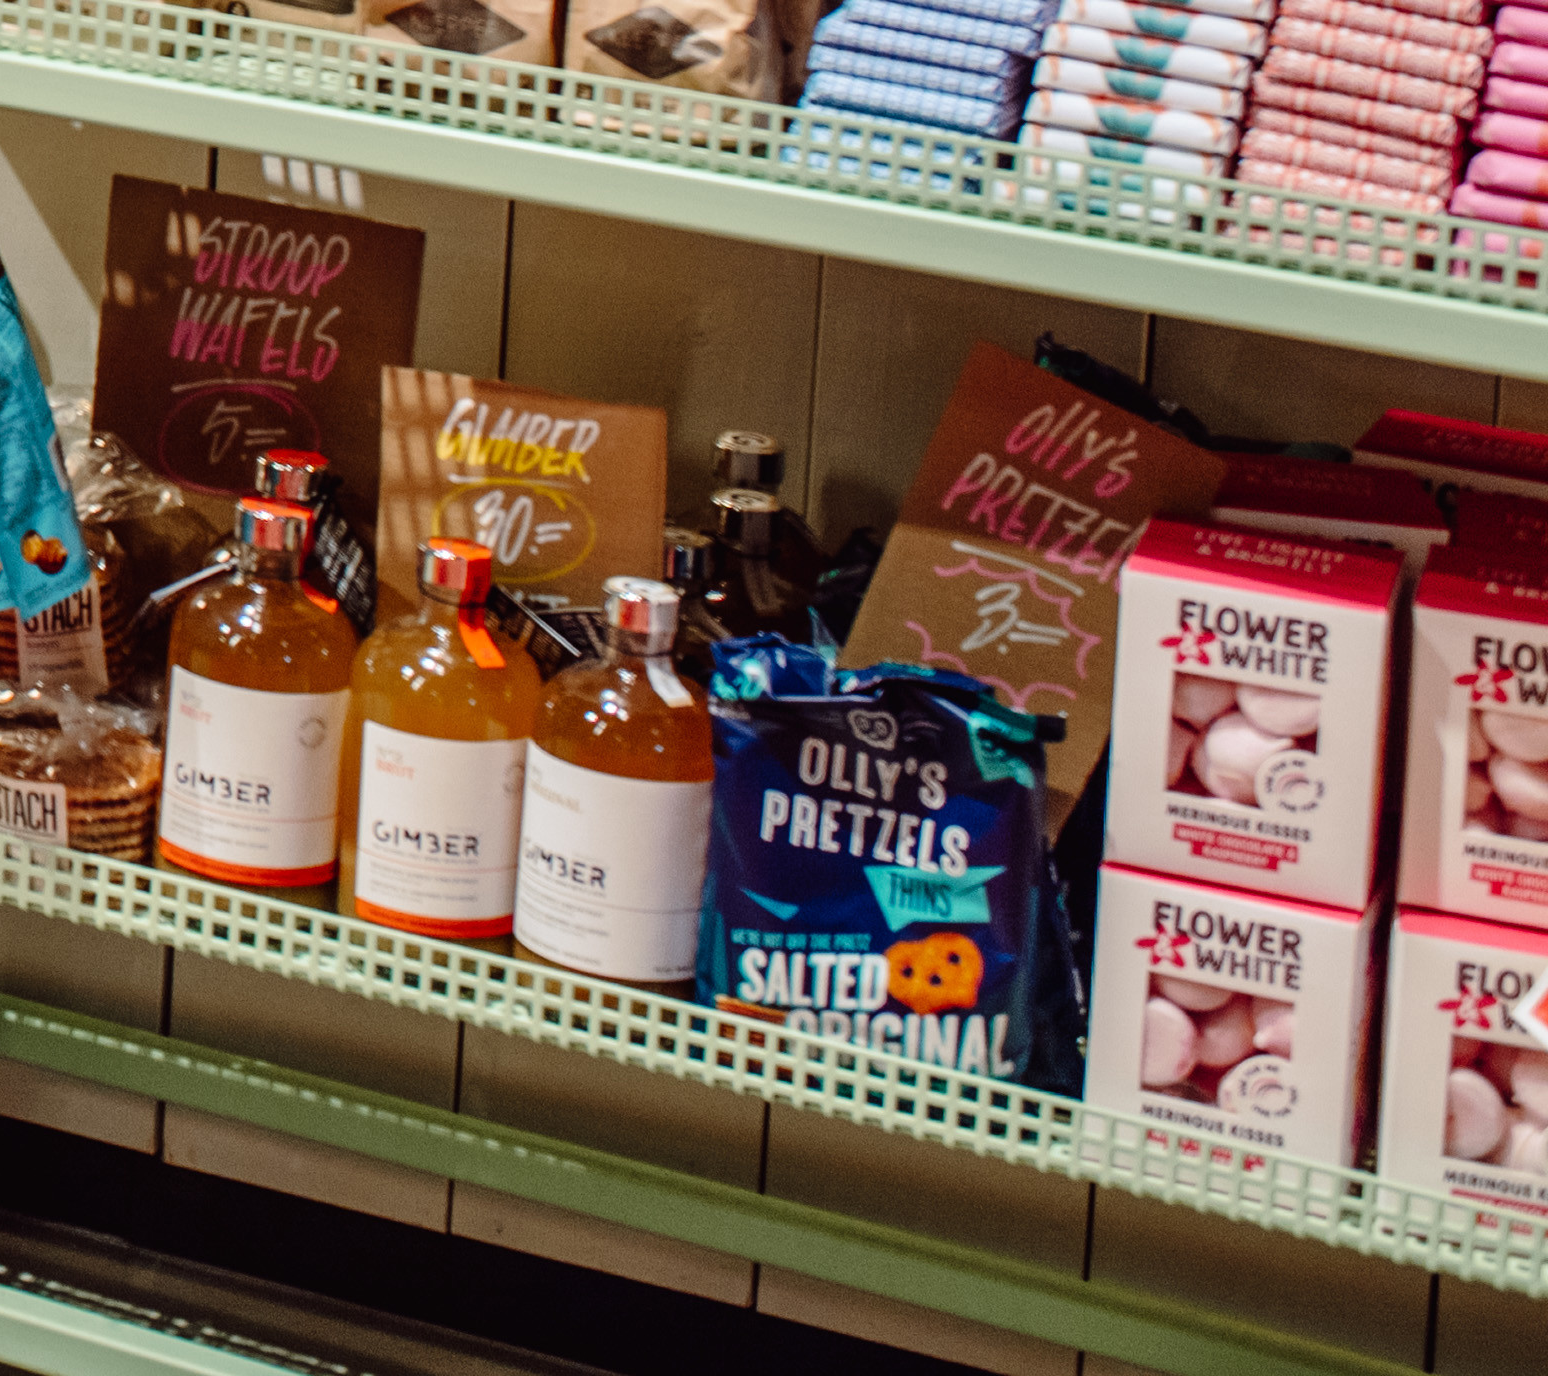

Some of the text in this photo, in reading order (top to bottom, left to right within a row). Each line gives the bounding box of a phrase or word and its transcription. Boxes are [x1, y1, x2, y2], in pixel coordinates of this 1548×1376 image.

[195, 217, 349, 297] STROOP
[171, 290, 340, 383] WAFELS
[436, 399, 600, 480] GIMBER
[1179, 599, 1328, 653] FLOWER
[1221, 642, 1327, 683] WHITE
[799, 737, 947, 809] OLLY'S
[760, 789, 969, 877] PRETZELS
[738, 948, 890, 1011] SALTED
